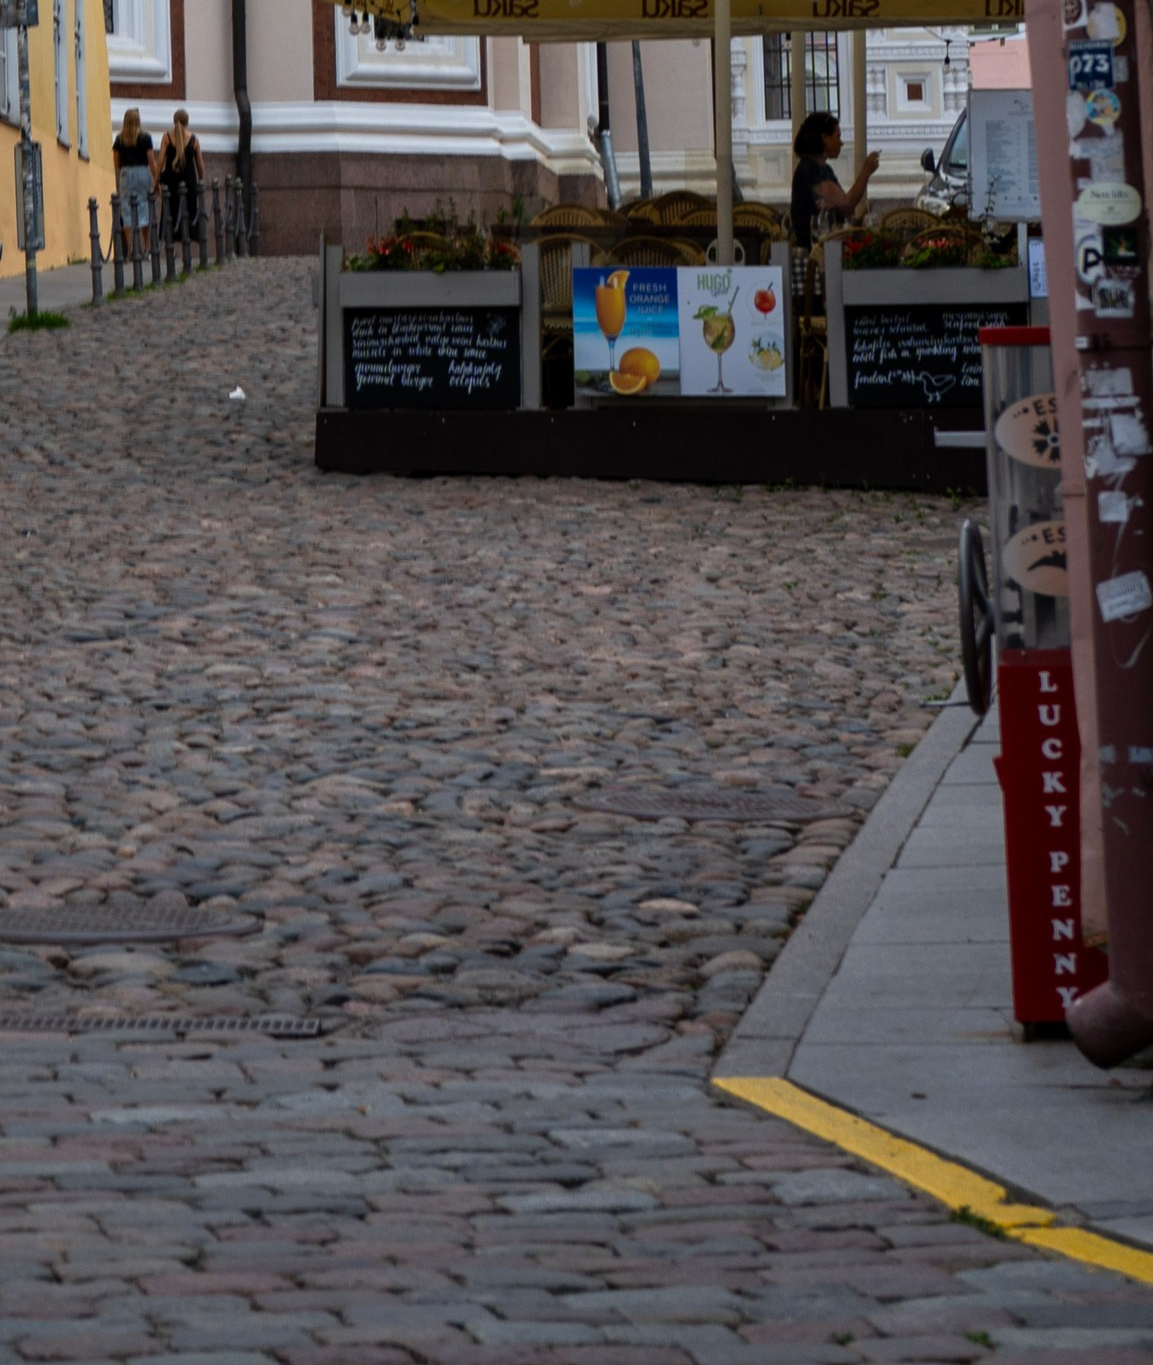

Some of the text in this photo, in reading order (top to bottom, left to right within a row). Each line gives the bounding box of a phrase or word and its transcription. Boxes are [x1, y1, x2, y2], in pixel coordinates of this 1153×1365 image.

[632, 282, 667, 293] FRESH
[696, 273, 731, 291] HUGO
[629, 293, 671, 304] ORANGE
[1038, 671, 1079, 1009] LUCKY PENNY
